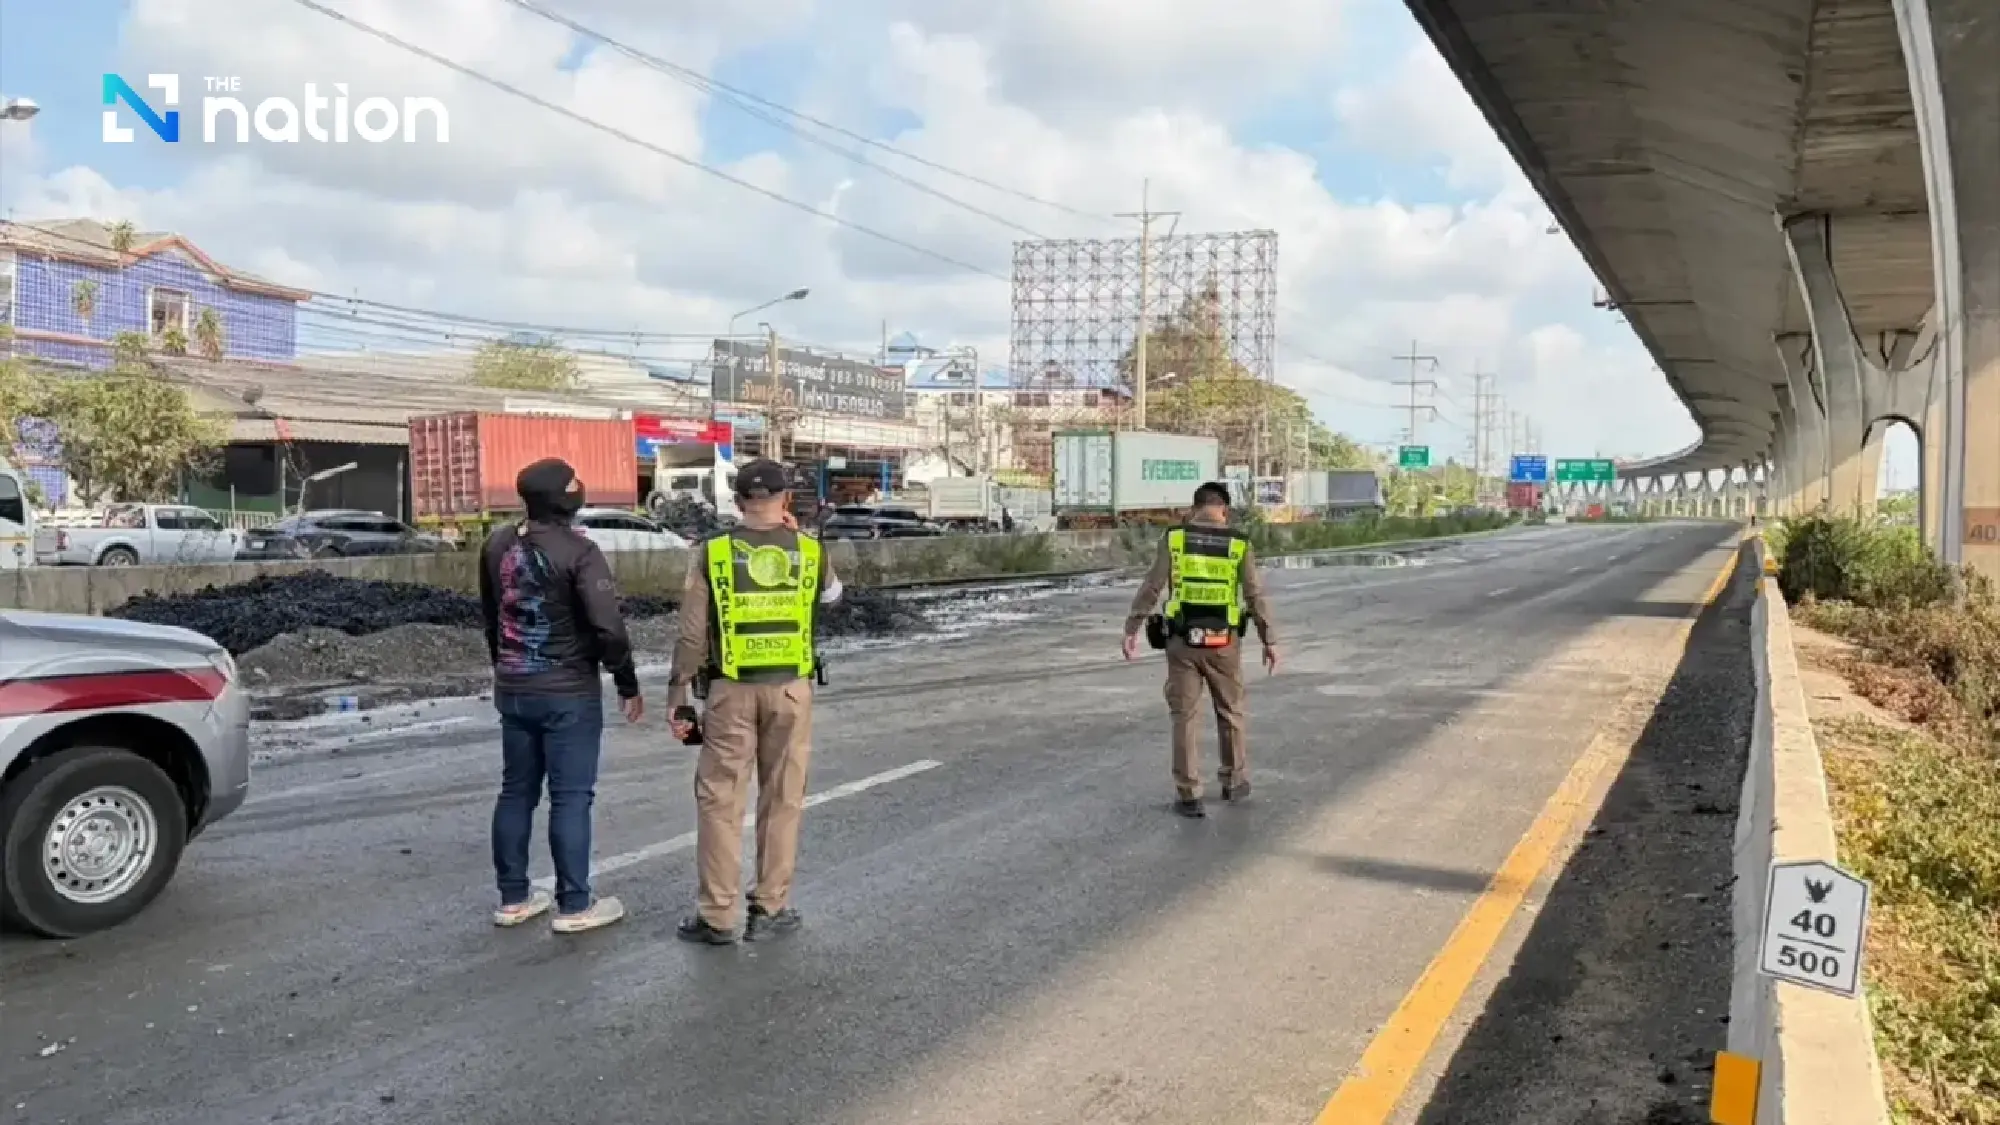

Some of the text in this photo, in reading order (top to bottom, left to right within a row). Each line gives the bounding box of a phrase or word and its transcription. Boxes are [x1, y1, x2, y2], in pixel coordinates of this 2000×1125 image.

[1142, 459, 1200, 480] EVERGREEN
[714, 561, 734, 665] TRAFFIC
[802, 557, 816, 663] POLICE
[746, 638, 791, 650] DENSO
[1789, 909, 1836, 938] 40
[1777, 944, 1839, 977] 500
